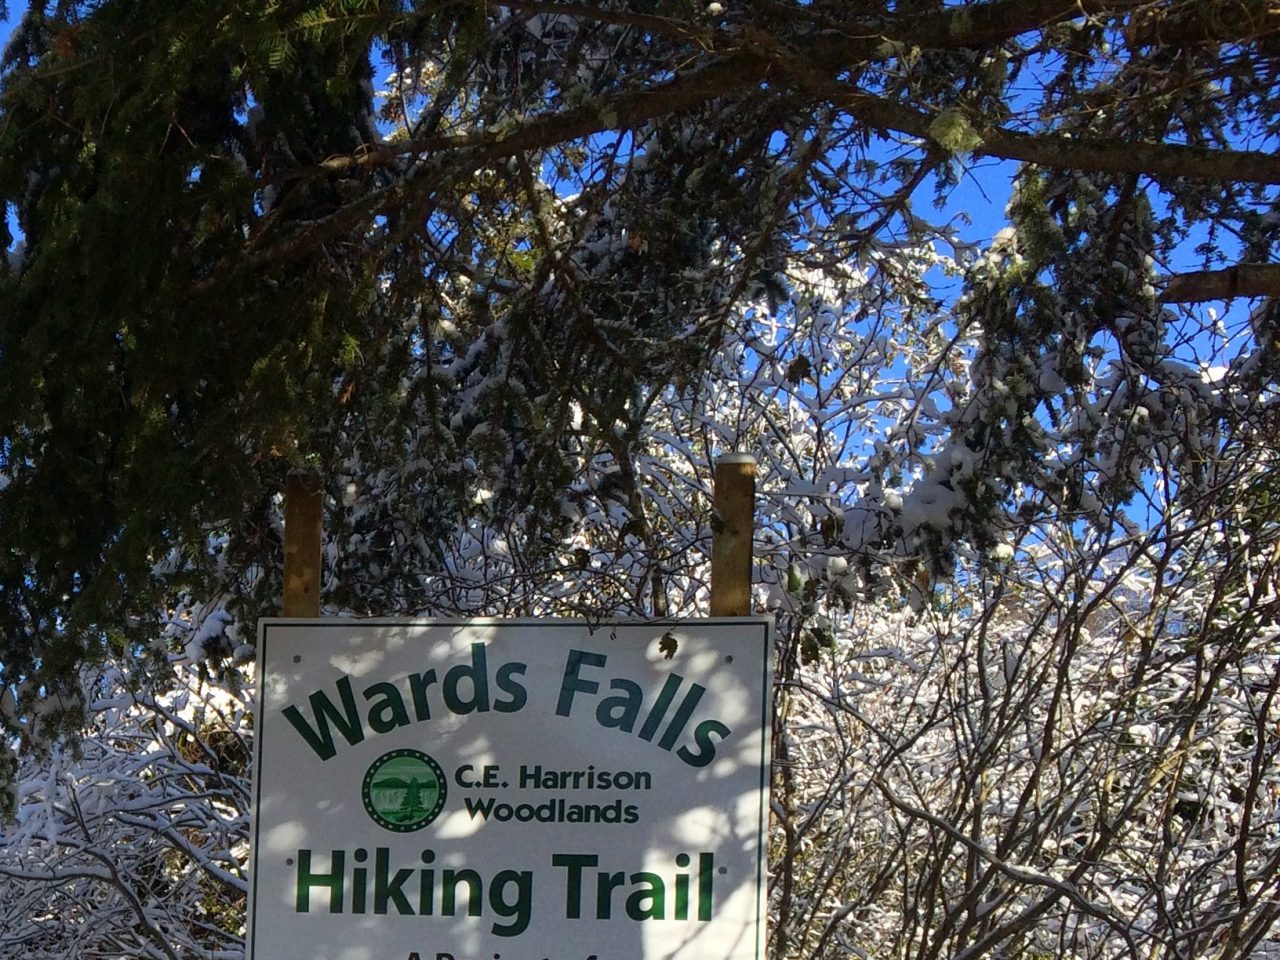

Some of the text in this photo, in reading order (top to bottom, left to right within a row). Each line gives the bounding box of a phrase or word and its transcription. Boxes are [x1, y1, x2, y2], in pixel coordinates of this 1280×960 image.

[281, 643, 731, 768] Wards Falls
[455, 765, 651, 790] C.E. Harrison
[465, 798, 639, 824] Woodlands
[296, 848, 713, 938] Hiking Trail
